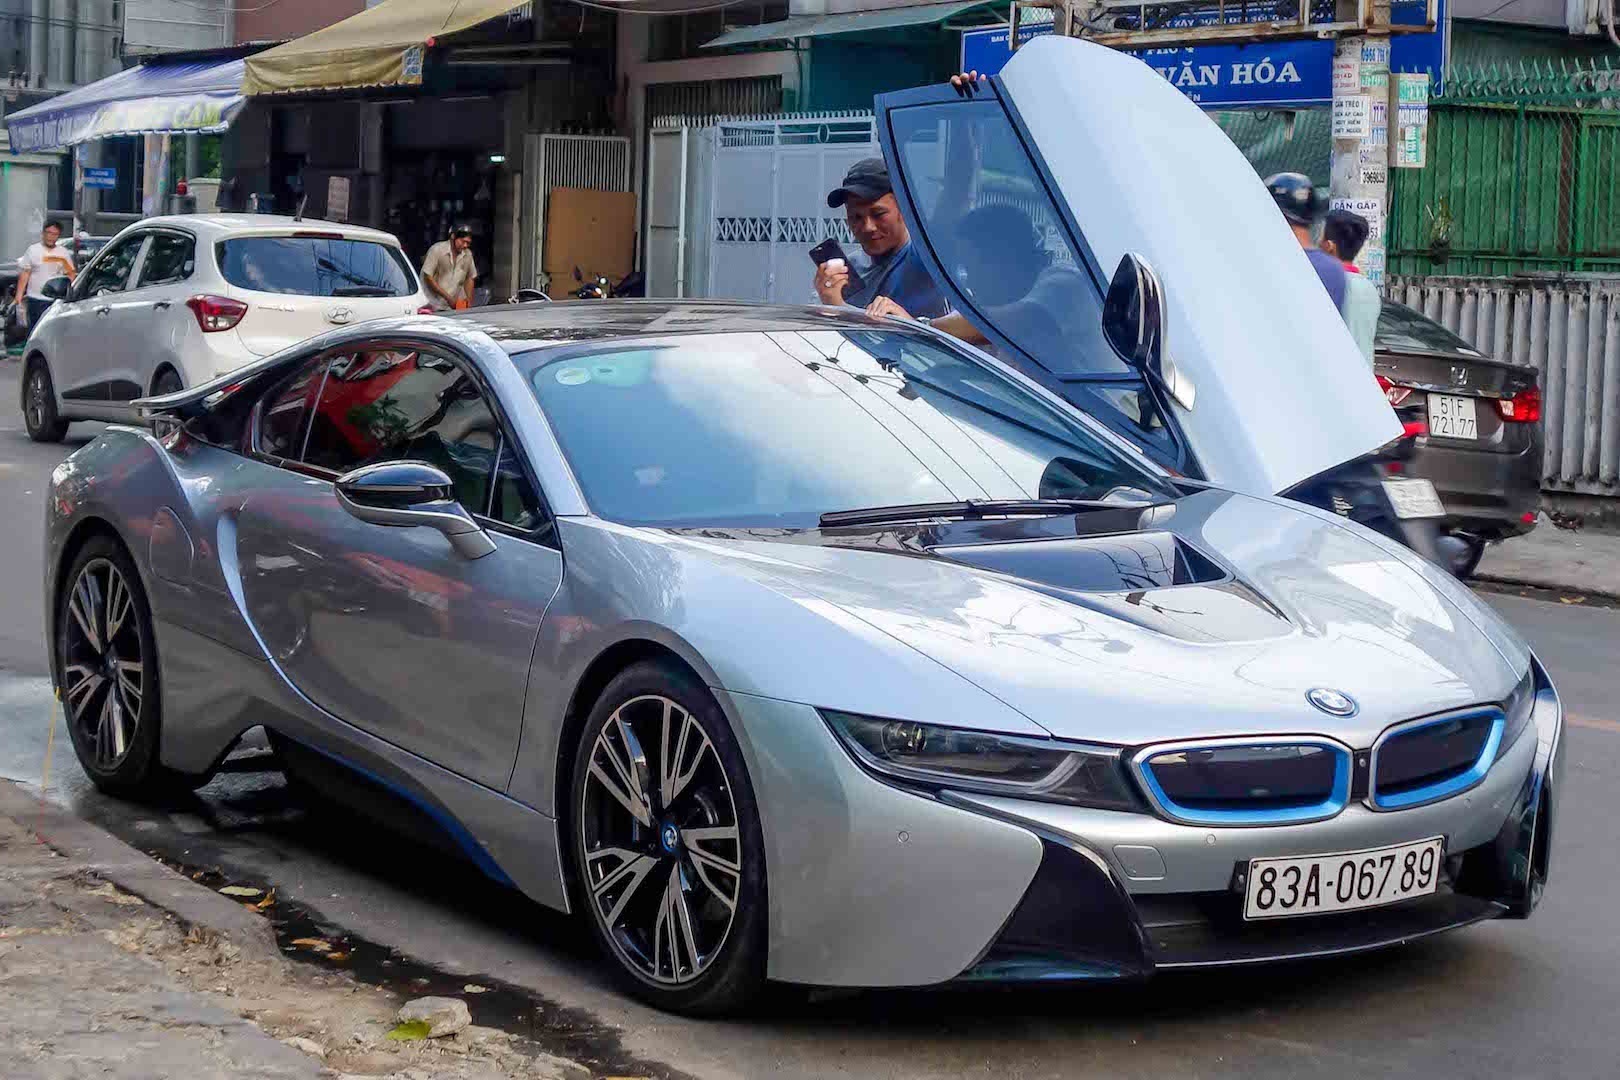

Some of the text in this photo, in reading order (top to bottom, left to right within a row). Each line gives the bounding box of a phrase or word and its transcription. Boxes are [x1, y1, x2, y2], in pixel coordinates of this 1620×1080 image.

[1155, 56, 1301, 87] VĂN HÓA
[1440, 397, 1464, 417] 51F
[1432, 415, 1475, 436] 721.77
[1255, 846, 1436, 910] 83A-067.89
